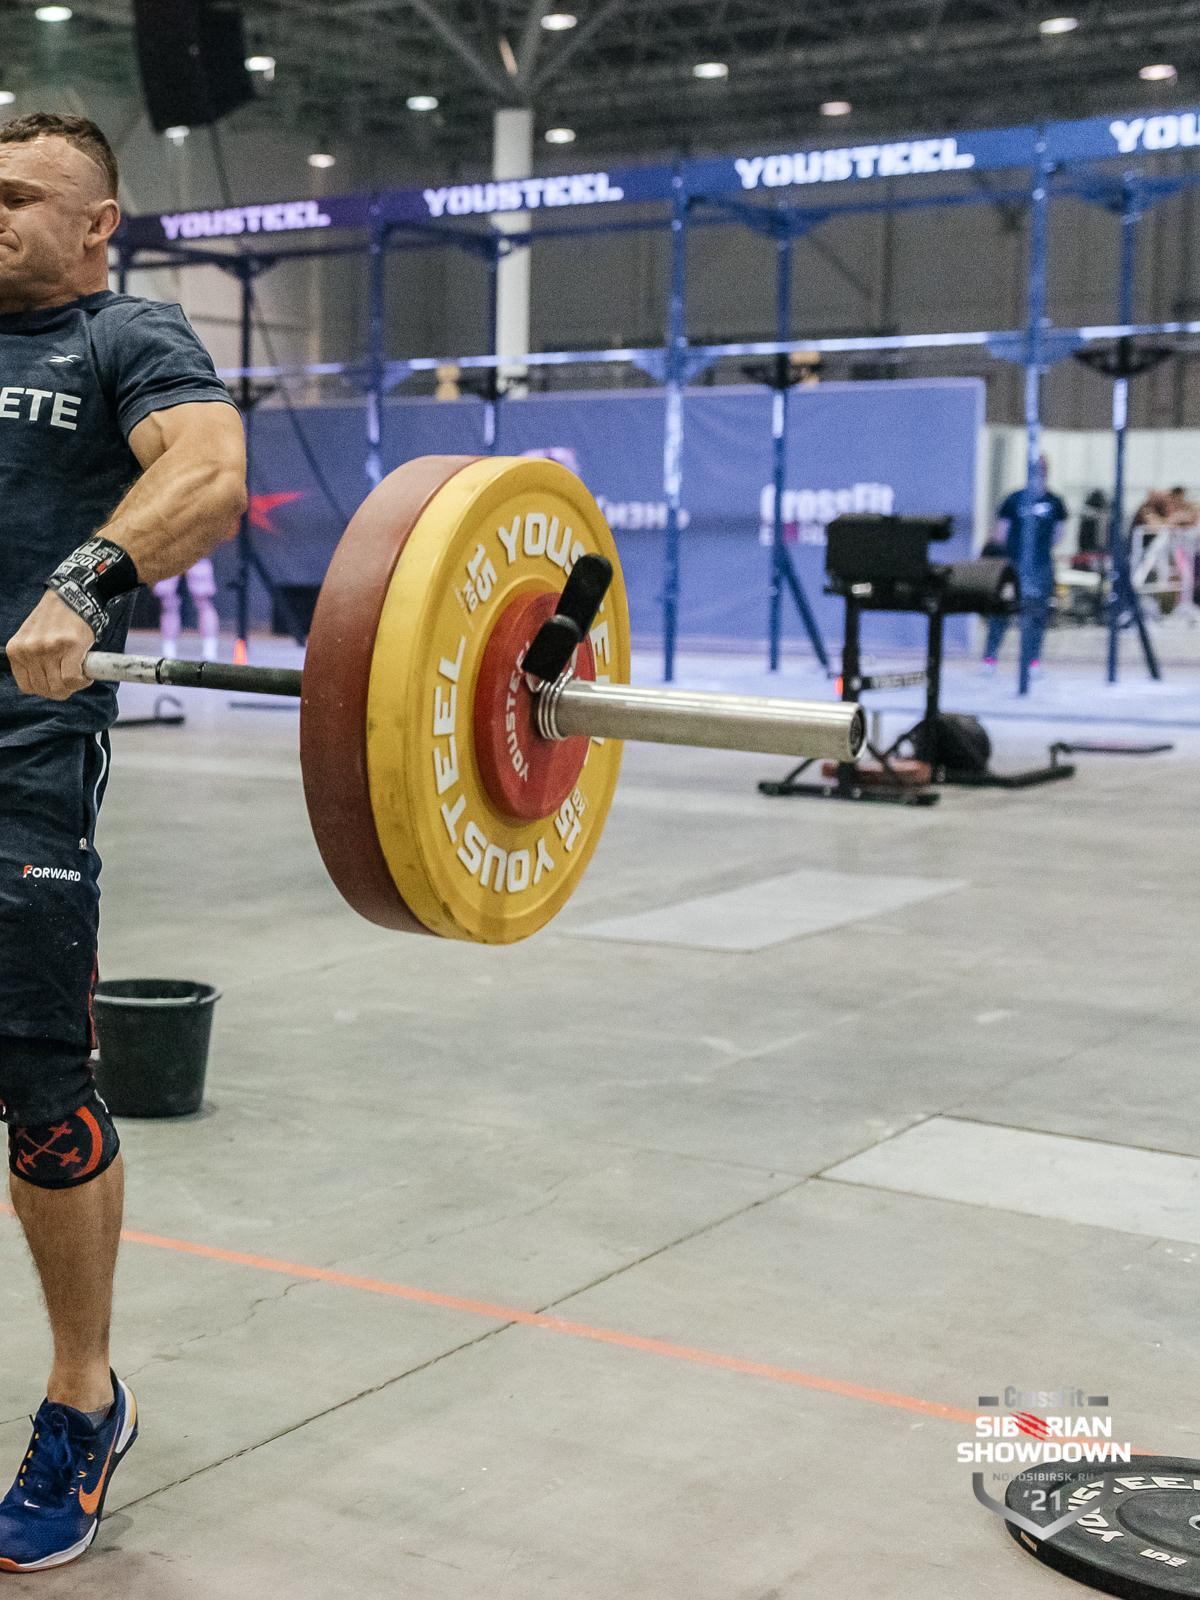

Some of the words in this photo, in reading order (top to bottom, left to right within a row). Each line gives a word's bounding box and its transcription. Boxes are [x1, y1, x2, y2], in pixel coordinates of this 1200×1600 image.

[734, 137, 976, 189] YOUSTEEL
[423, 172, 625, 217] YOUSTEEL
[160, 200, 332, 240] YOUSTEEL
[467, 544, 497, 602] 15
[433, 635, 555, 894] YOUSTEEL
[554, 797, 582, 853] 15
[22, 863, 81, 882] FORWARD
[1140, 1548, 1171, 1562] 5
